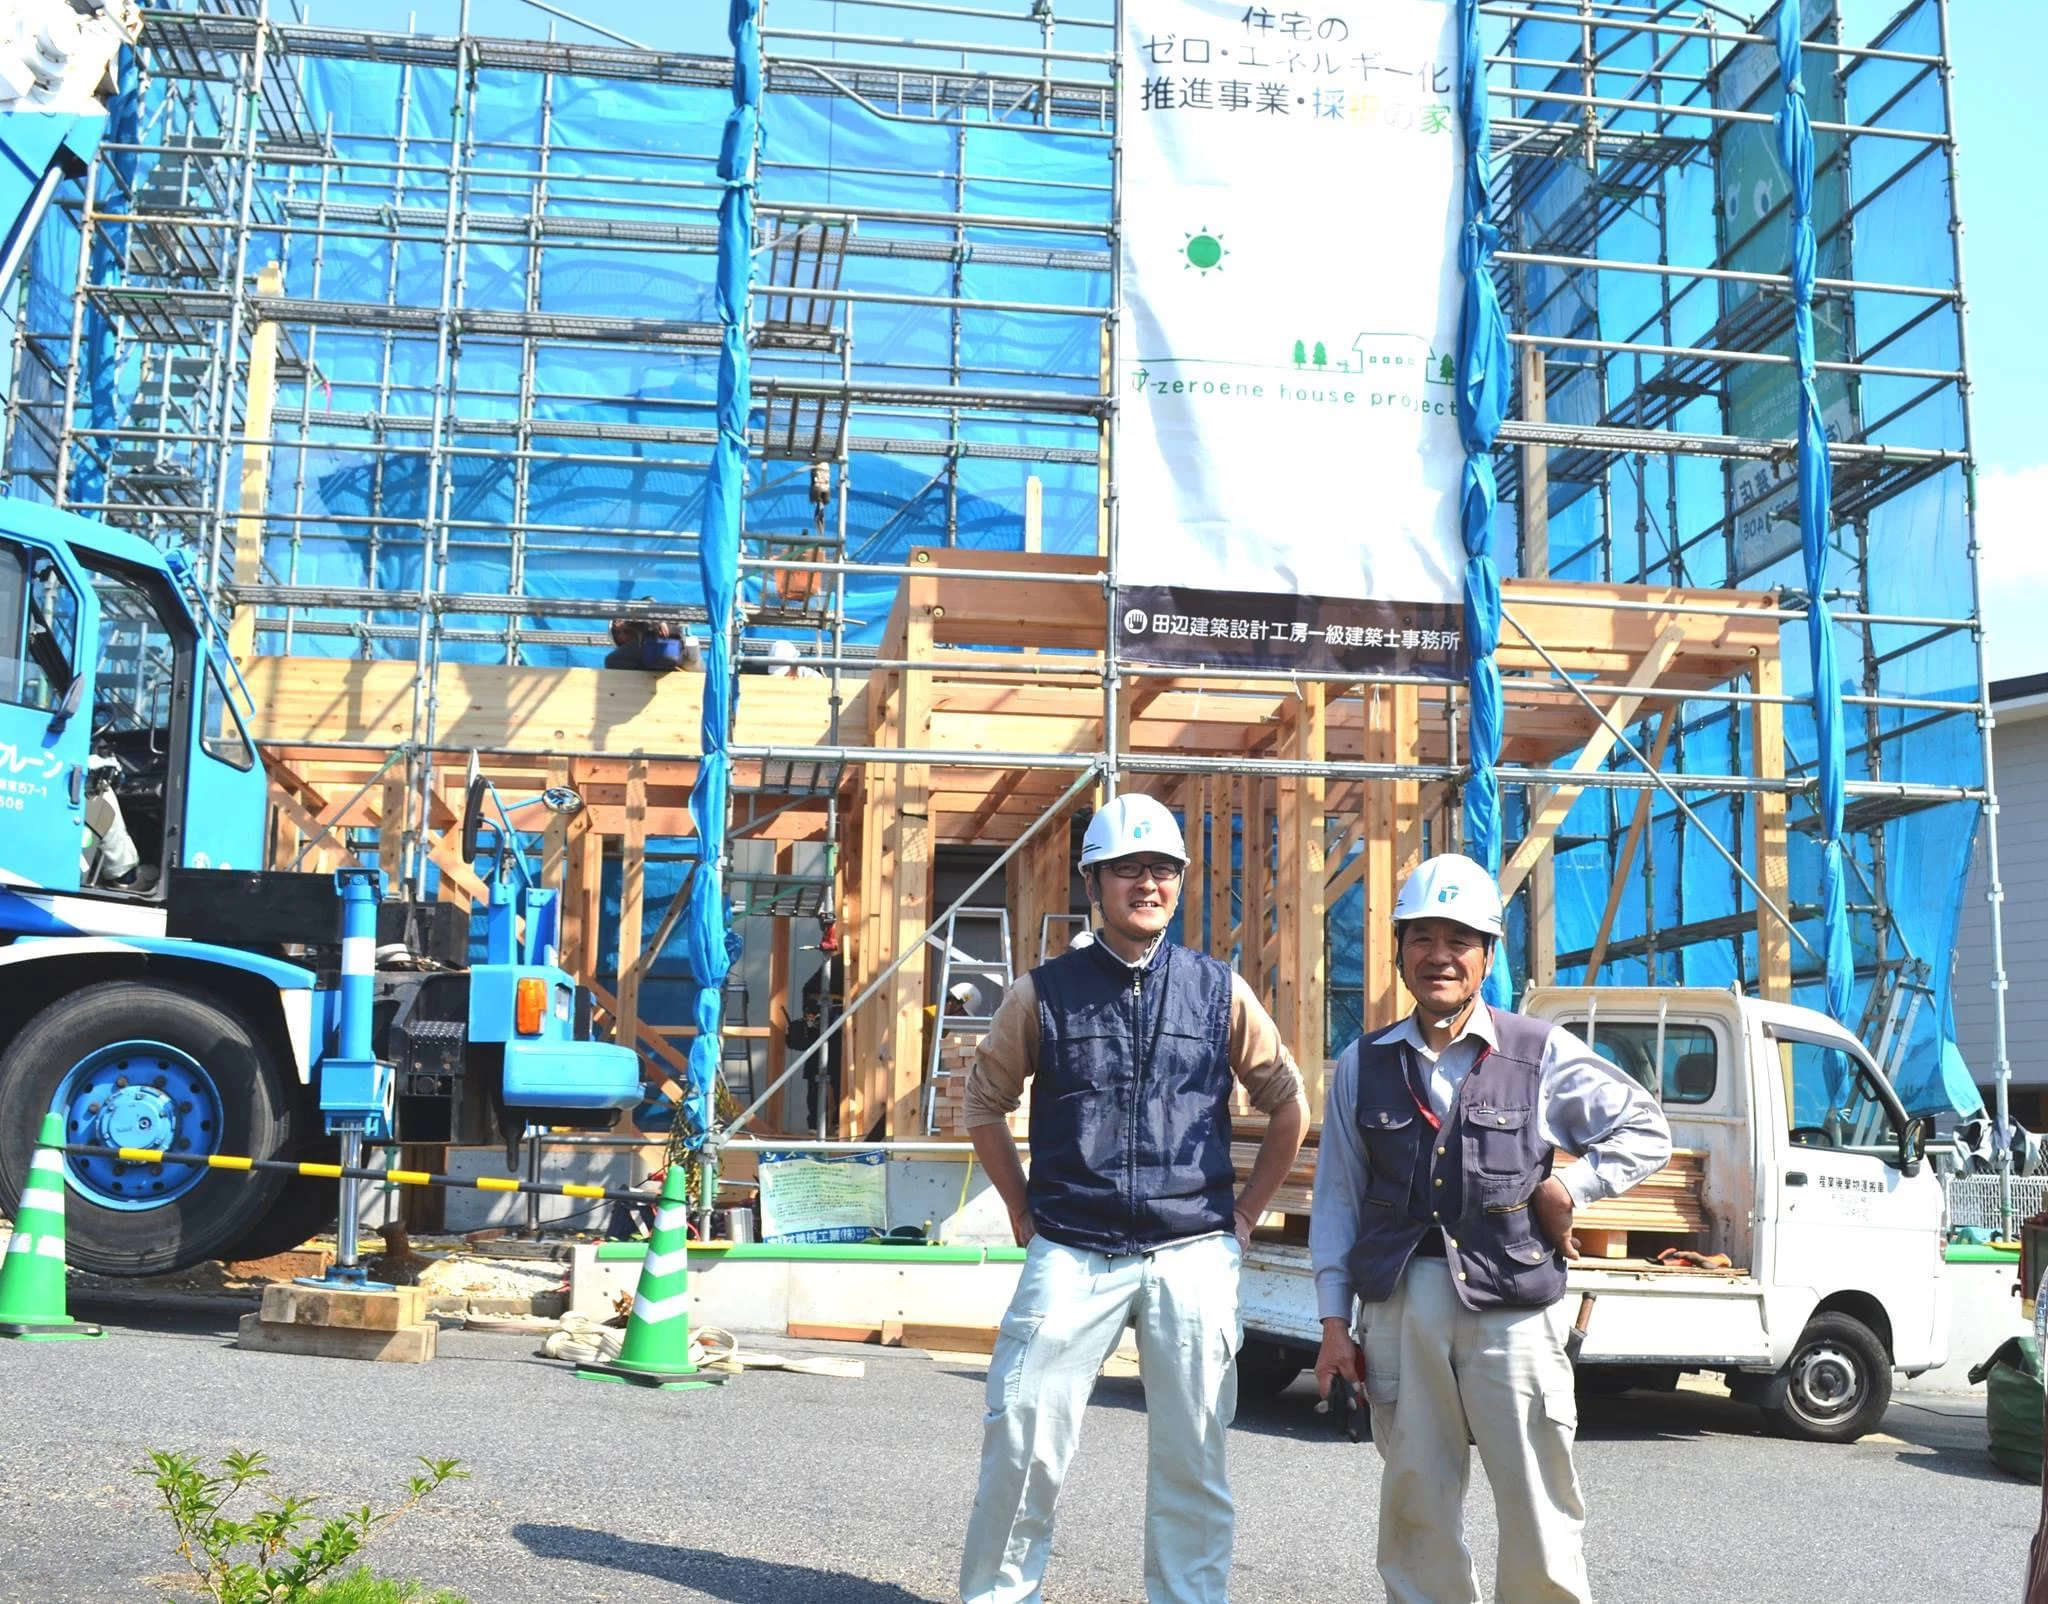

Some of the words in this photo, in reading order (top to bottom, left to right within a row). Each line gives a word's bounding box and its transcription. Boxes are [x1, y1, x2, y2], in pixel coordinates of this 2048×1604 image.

[1241, 7, 1348, 41] 住宅の
[1142, 34, 1451, 95] ゼロ・エネルギー化
[1280, 383, 1356, 404] house
[1370, 391, 1458, 417] project
